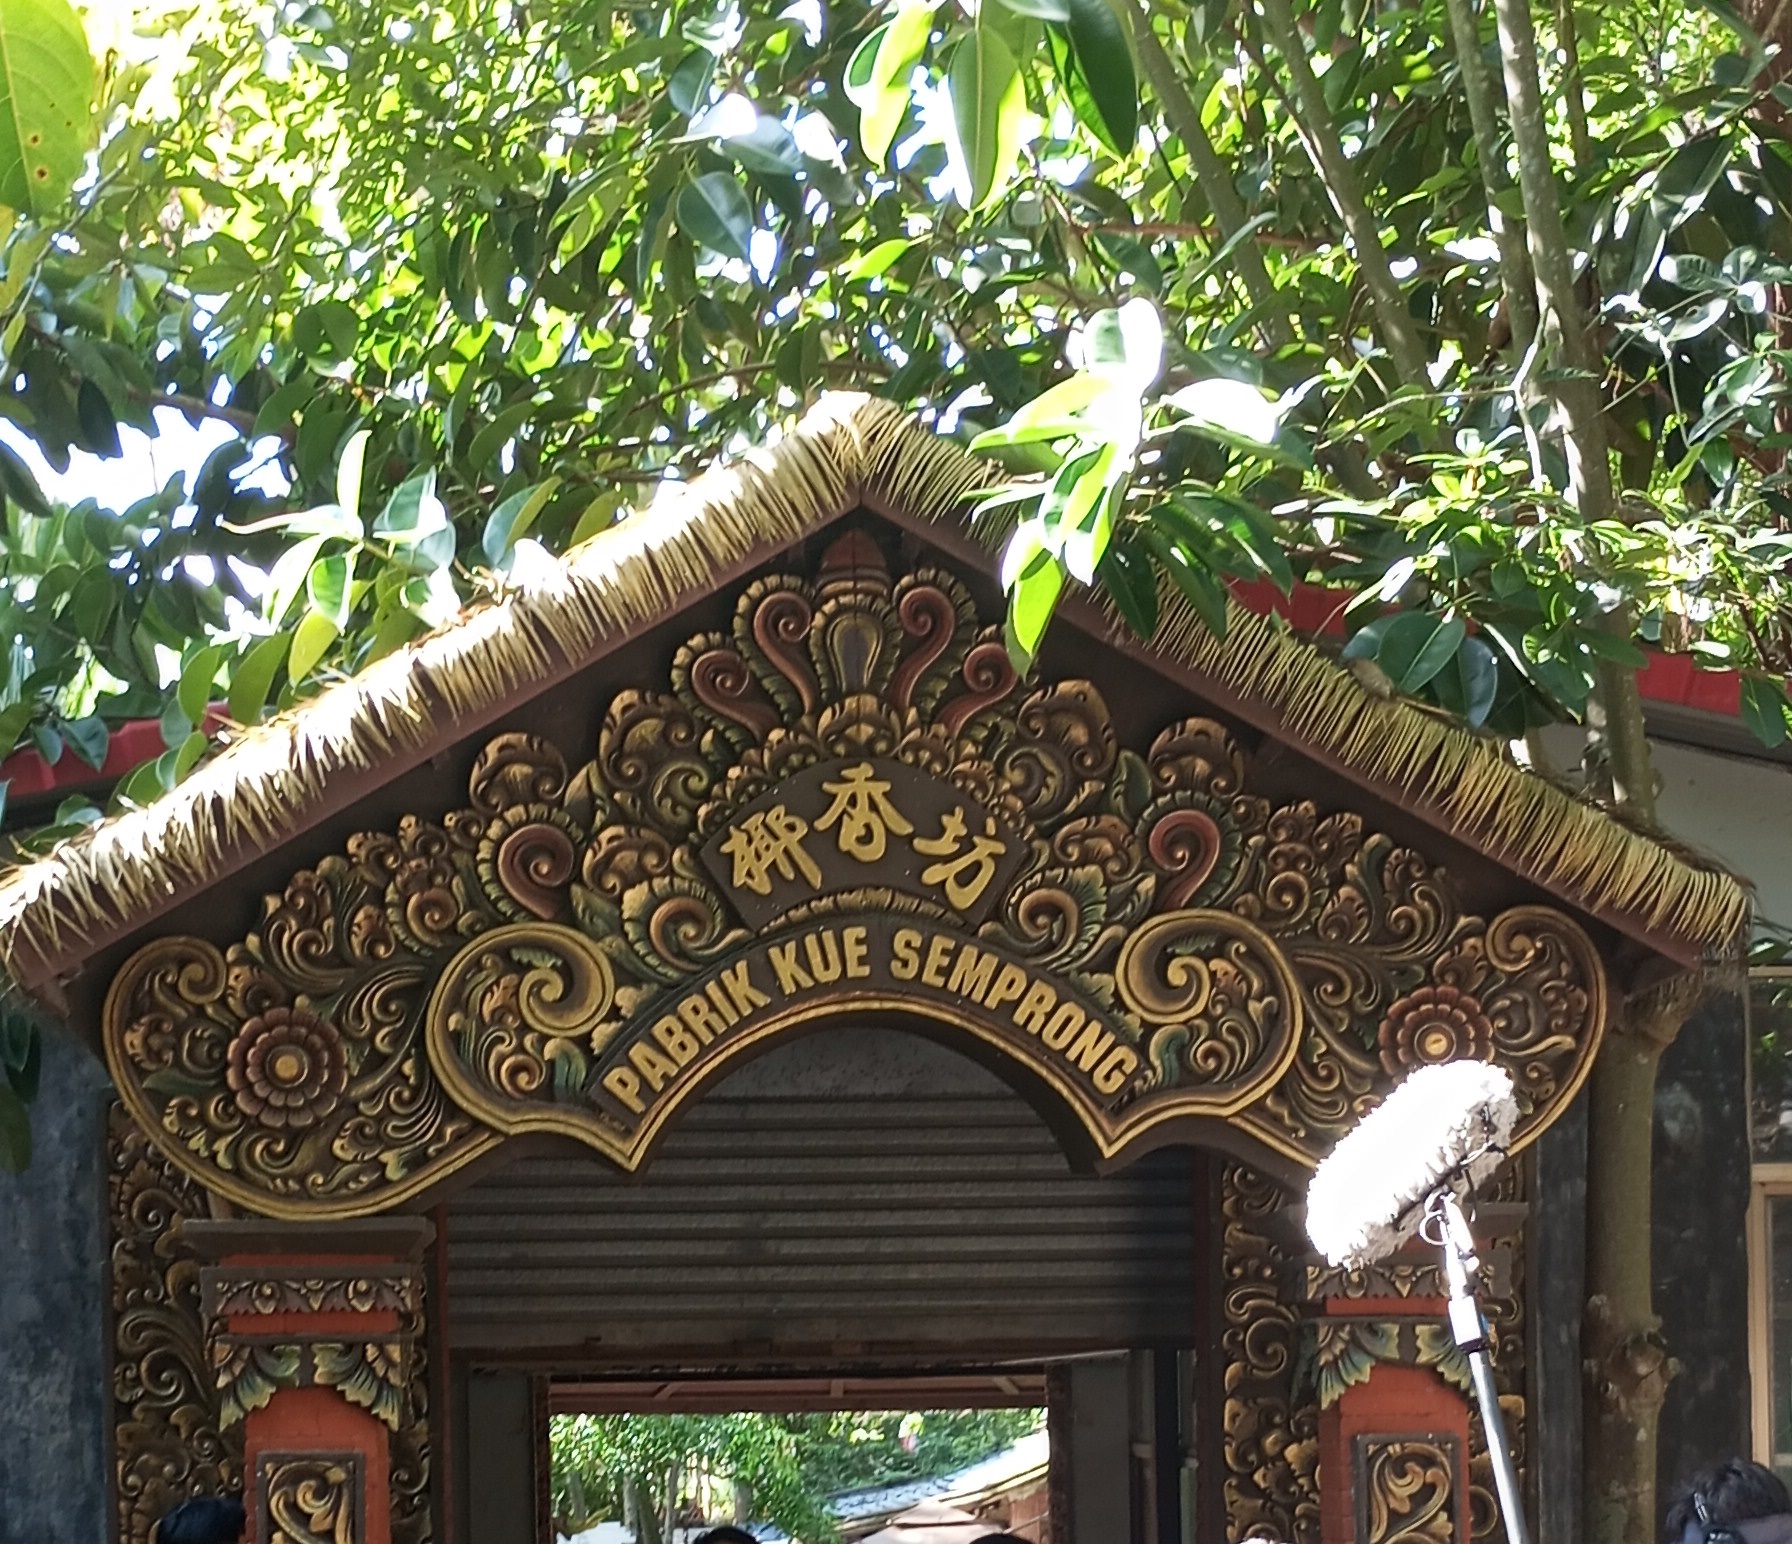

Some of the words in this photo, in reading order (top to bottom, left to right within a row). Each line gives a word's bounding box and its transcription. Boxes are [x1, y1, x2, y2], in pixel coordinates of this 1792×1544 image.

[719, 761, 1007, 911] 椰香坊
[602, 959, 772, 1115] PABRIK
[768, 925, 871, 996] KUE
[889, 927, 1139, 1095] SEMPRONG
